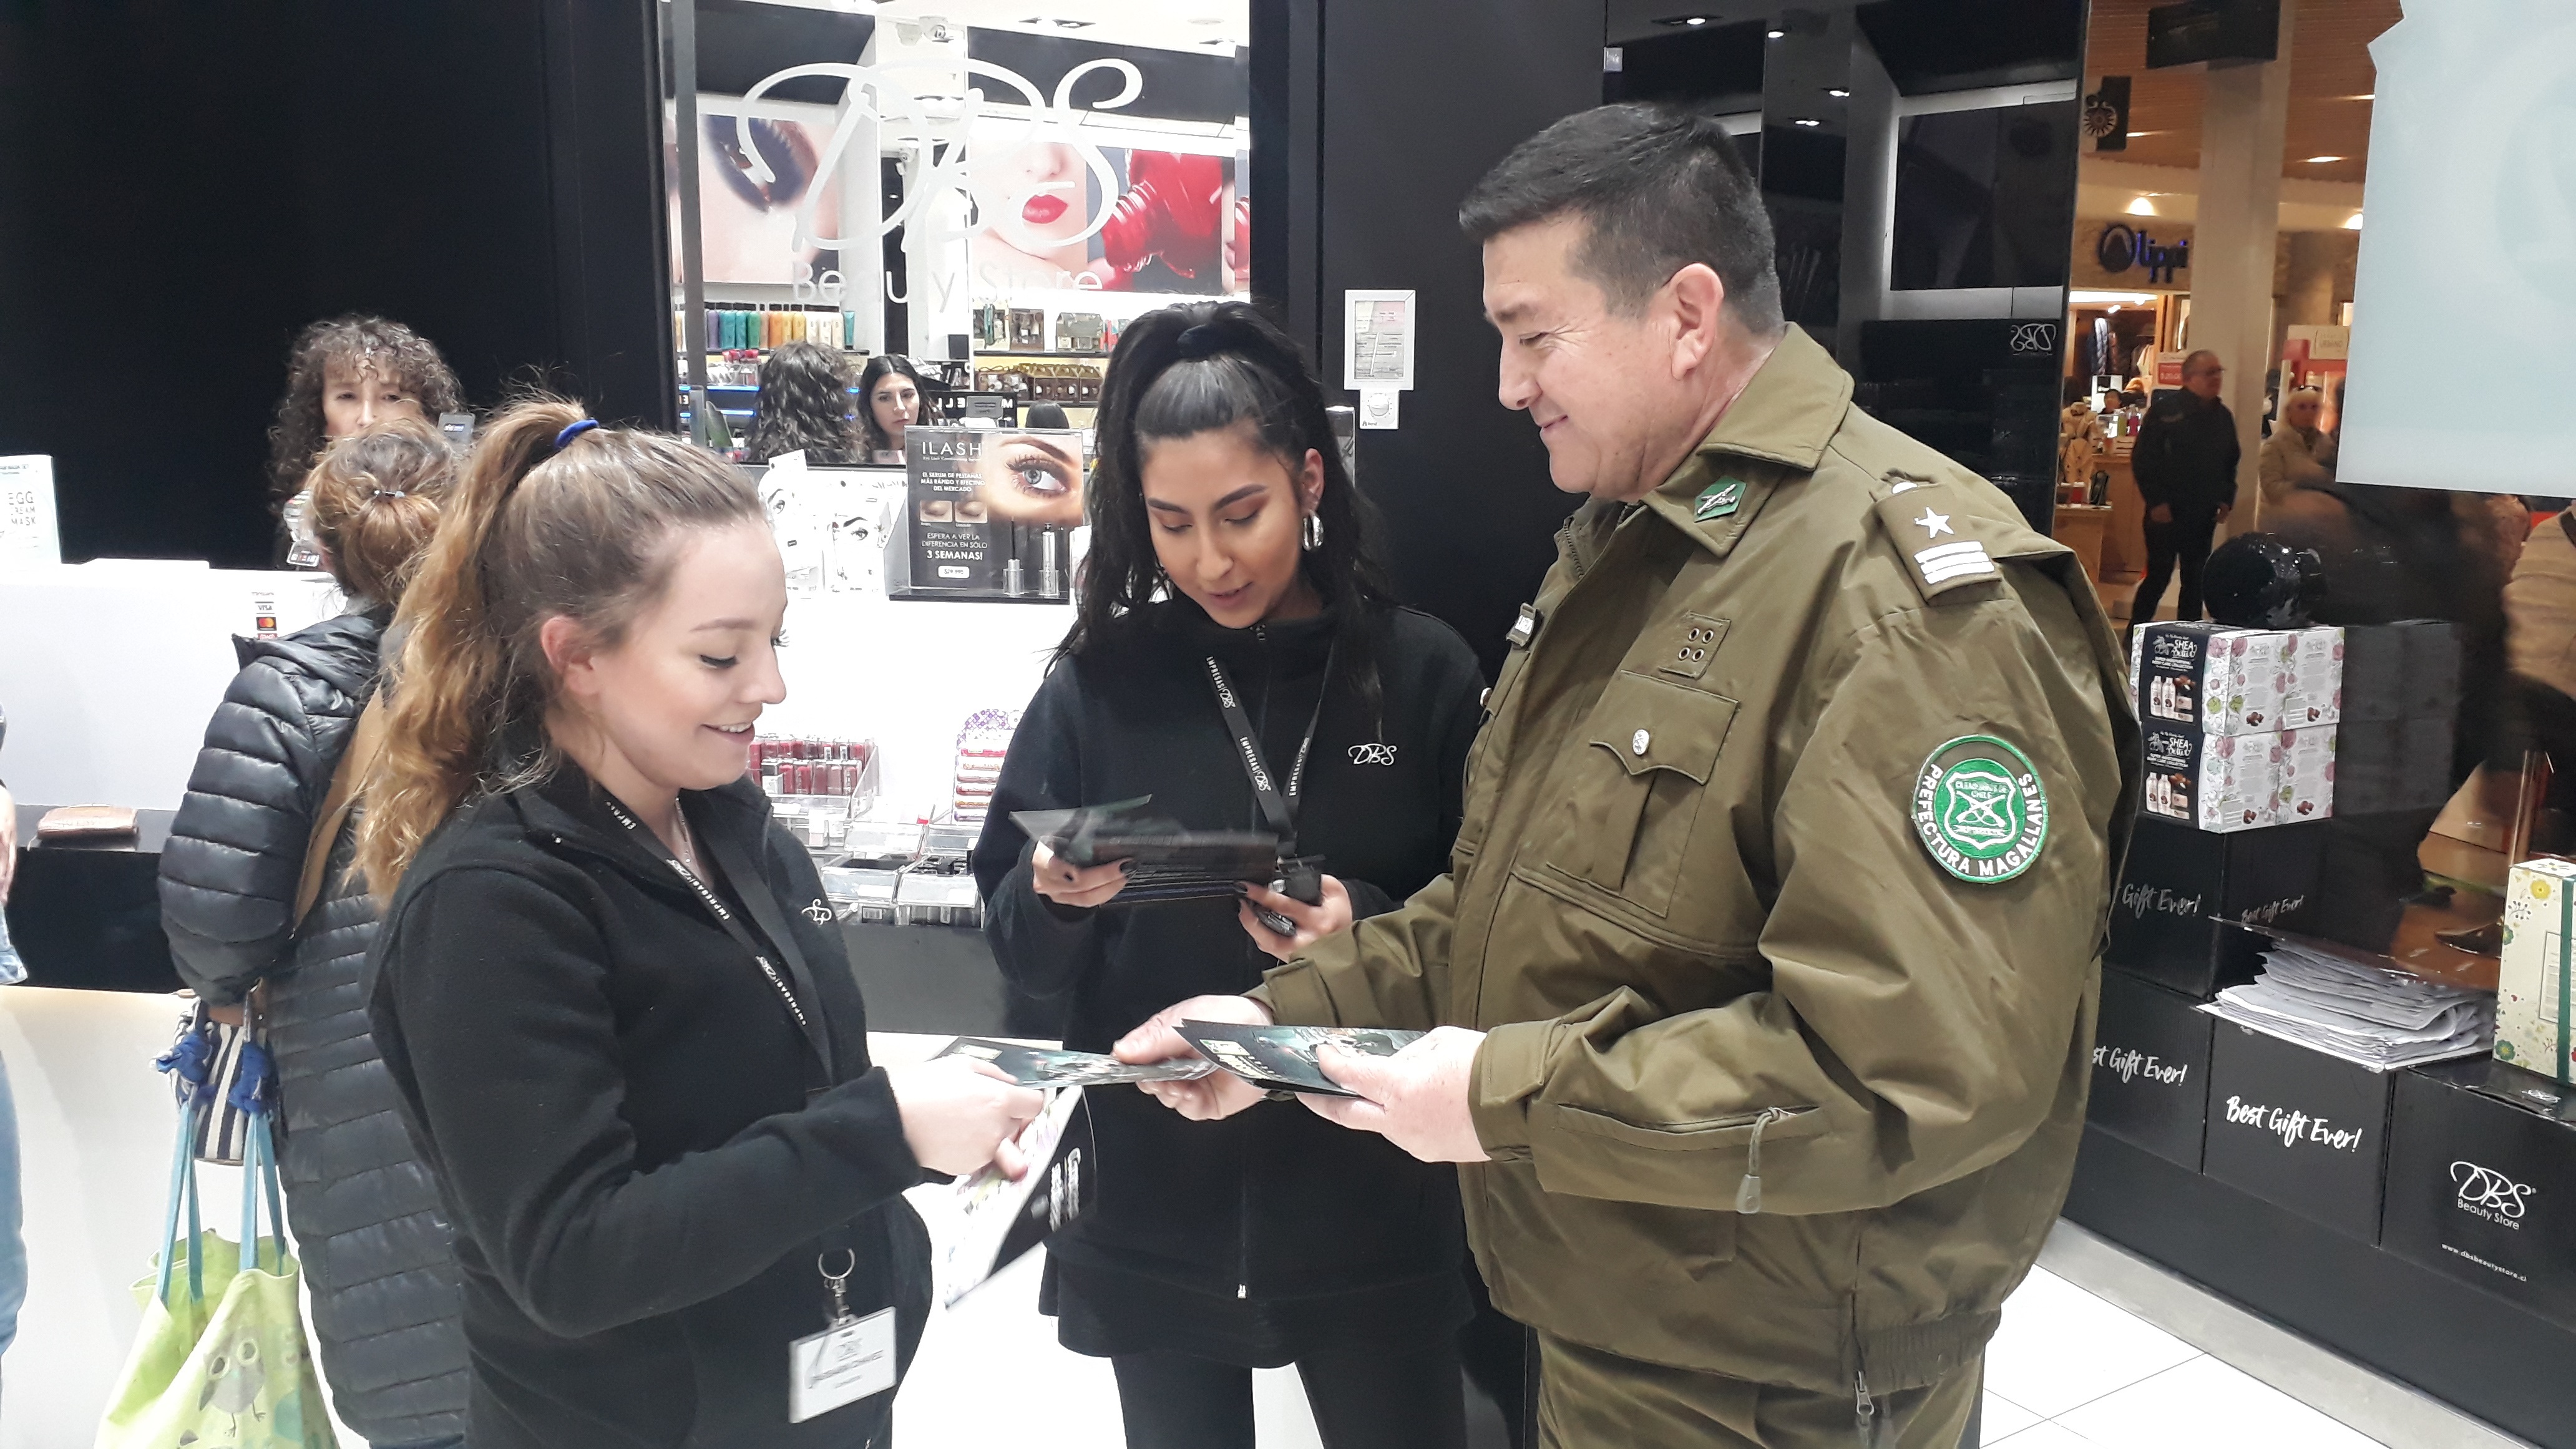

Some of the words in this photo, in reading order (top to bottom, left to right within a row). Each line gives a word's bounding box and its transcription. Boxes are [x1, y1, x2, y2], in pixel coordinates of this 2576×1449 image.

[793, 261, 956, 313] Beuy
[922, 441, 982, 456] ILASH
[8, 490, 34, 505] EGG
[926, 550, 933, 559] 3
[934, 550, 983, 560] SEMANAS!
[2174, 639, 2194, 651] SHEA
[1347, 743, 1397, 766] DBS
[2169, 737, 2189, 748] SHEA
[1918, 764, 1970, 874] PREFECTURA
[1978, 773, 2042, 876] MAGALLANES
[2122, 883, 2157, 919] Gift
[2109, 1046, 2145, 1084] Gift
[2144, 1056, 2188, 1087] Ever!
[2226, 1095, 2271, 1128] Best
[2268, 1107, 2312, 1148] Gift
[2310, 1118, 2363, 1153] Ever!
[2450, 1161, 2532, 1218] DBS
[2457, 1198, 2492, 1221] Beauty
[2493, 1212, 2520, 1230] Store
